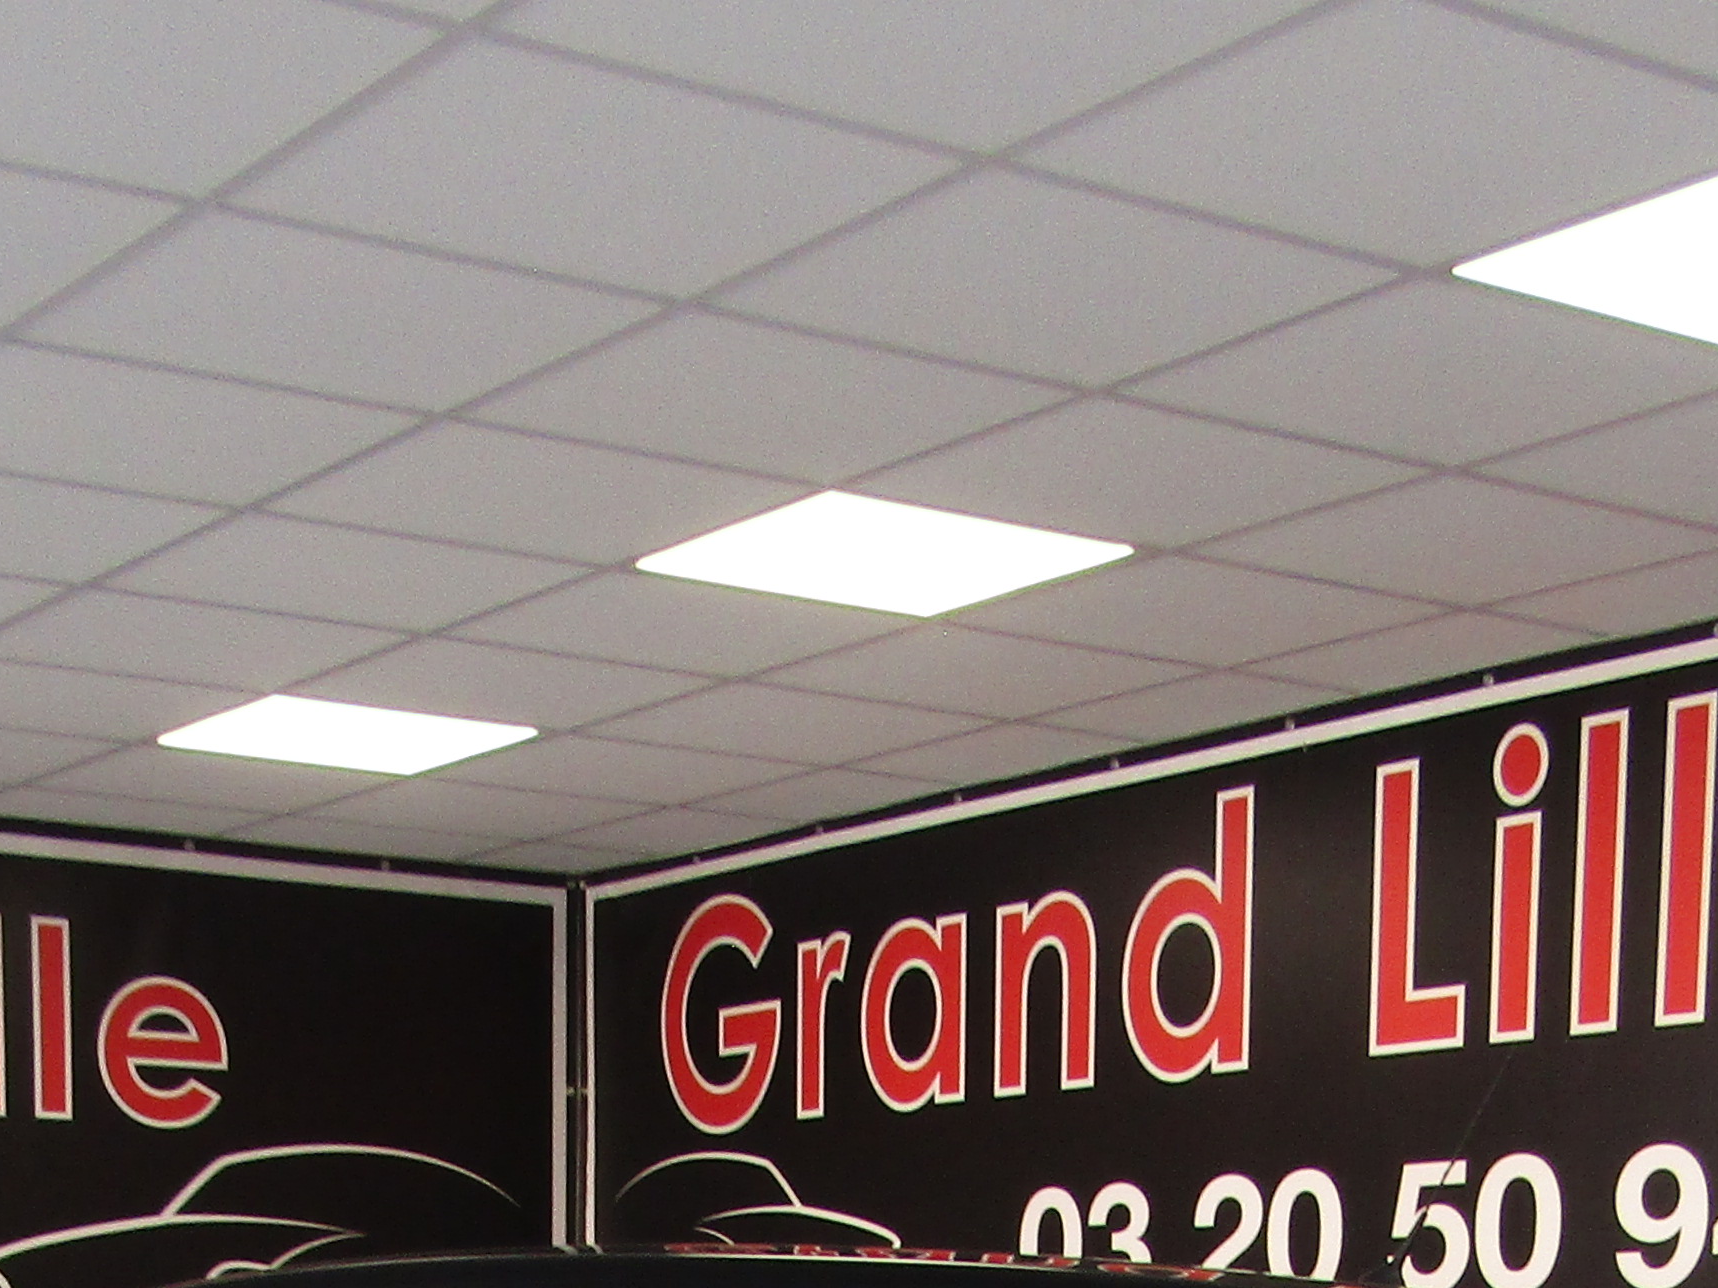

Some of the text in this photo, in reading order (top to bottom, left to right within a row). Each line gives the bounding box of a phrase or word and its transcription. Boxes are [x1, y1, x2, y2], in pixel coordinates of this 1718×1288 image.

[659, 785, 1255, 1136] Grand
[1019, 1180, 1152, 1264] 03
[1193, 1166, 1344, 1282] 20
